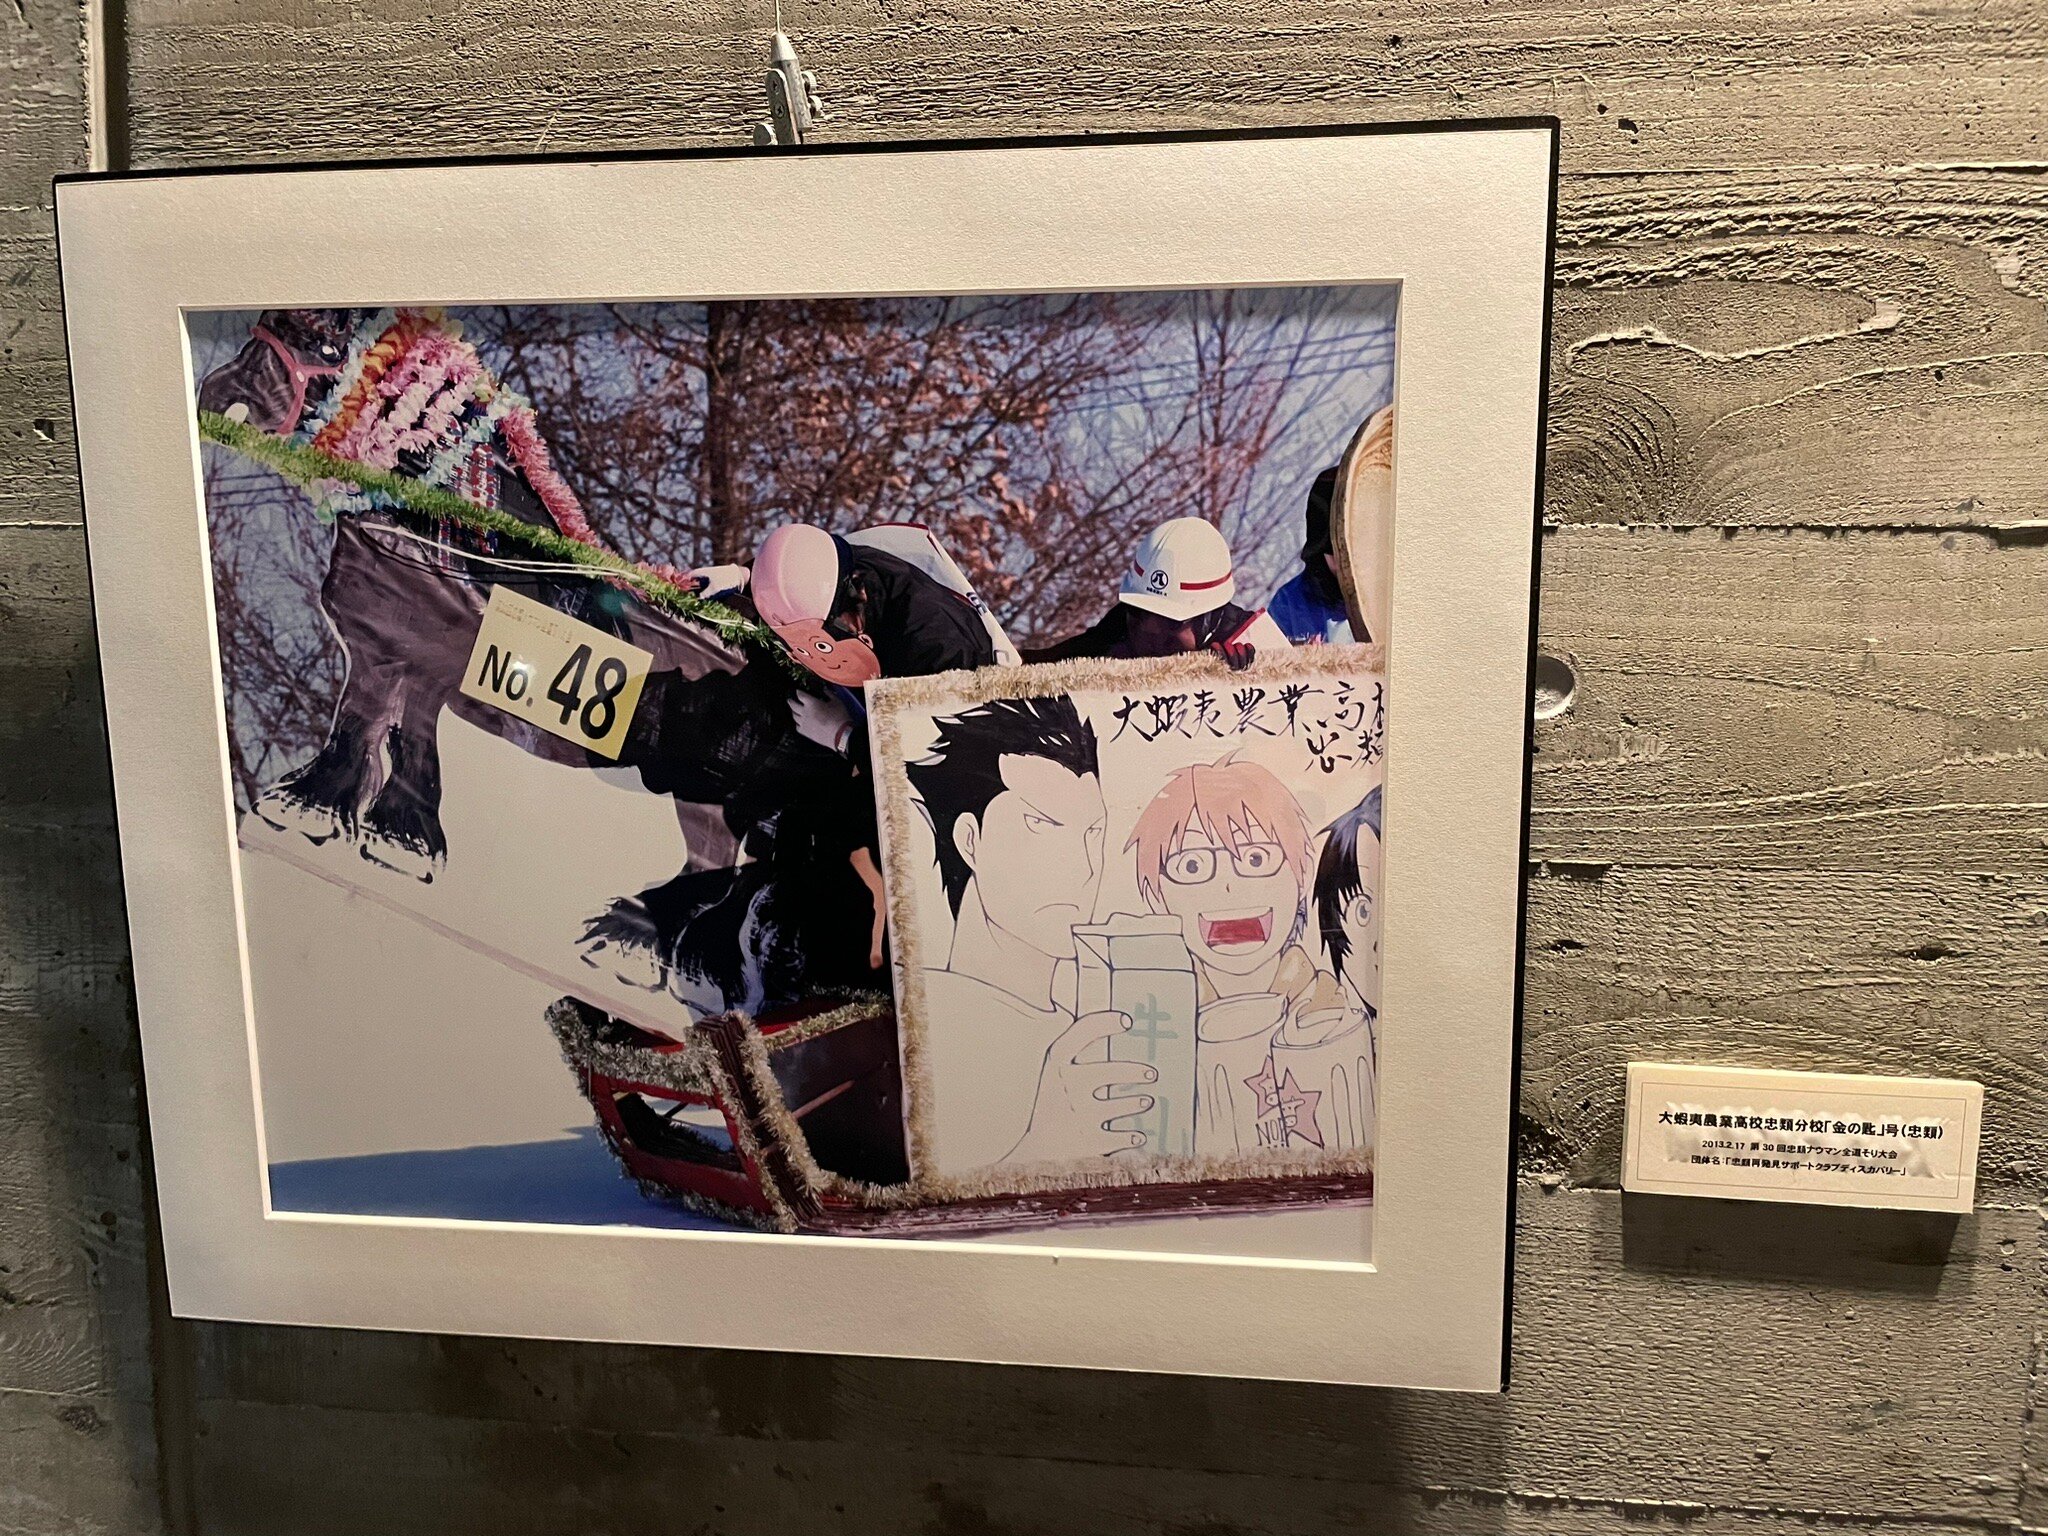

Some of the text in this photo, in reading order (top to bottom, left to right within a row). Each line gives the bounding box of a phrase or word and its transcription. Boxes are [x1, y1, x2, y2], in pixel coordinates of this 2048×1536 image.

[477, 643, 627, 740] No. 48
[1702, 1140, 1745, 1150] 2013.2.17
[1750, 1142, 1760, 1151] 第
[1762, 1143, 1774, 1151] 30
